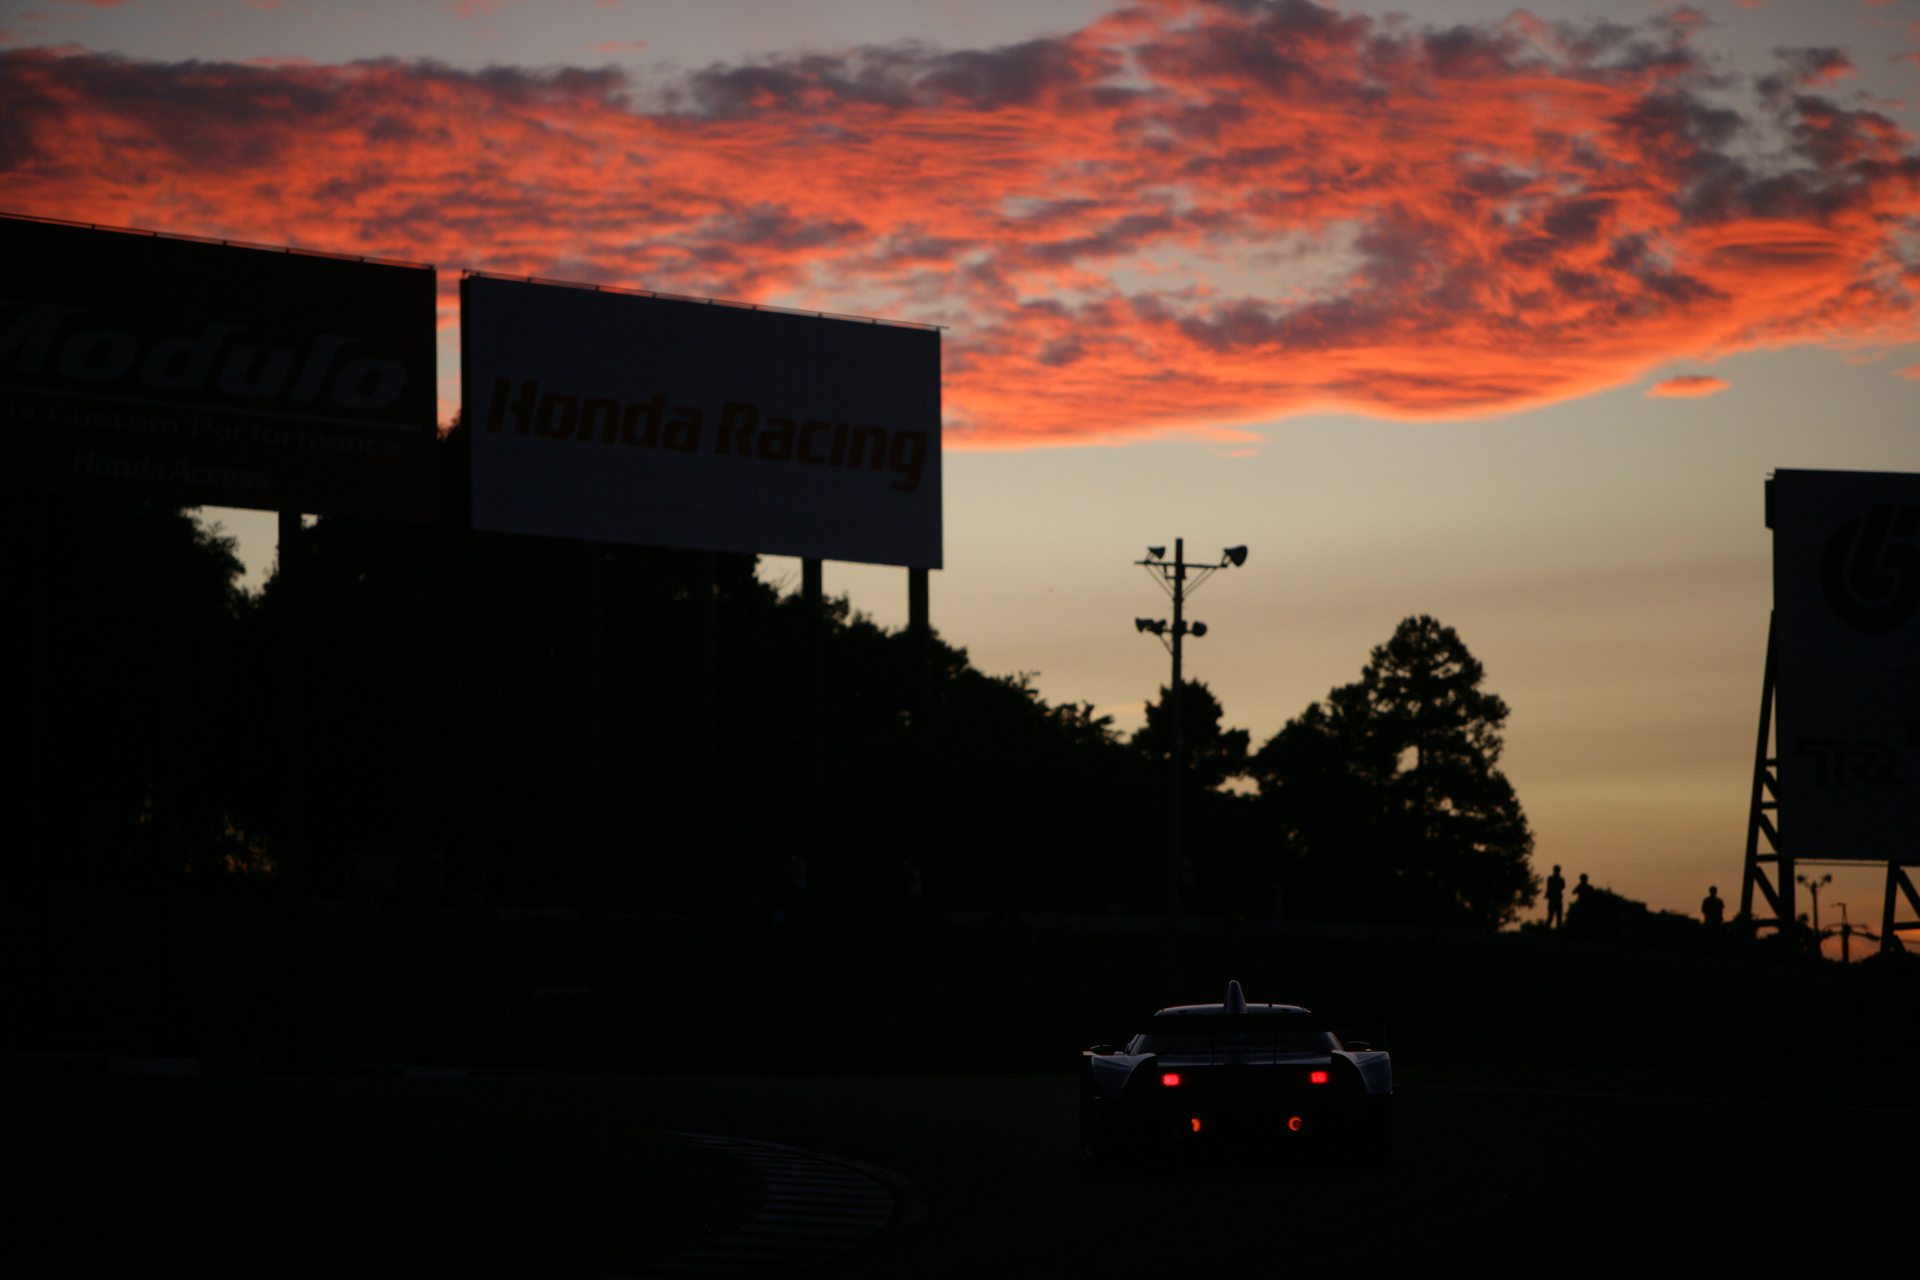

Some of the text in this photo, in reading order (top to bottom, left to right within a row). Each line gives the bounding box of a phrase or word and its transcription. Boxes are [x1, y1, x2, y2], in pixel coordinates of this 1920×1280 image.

[48, 403, 179, 435] Custom
[191, 415, 401, 456] Performance
[486, 377, 929, 491] Honda Racing
